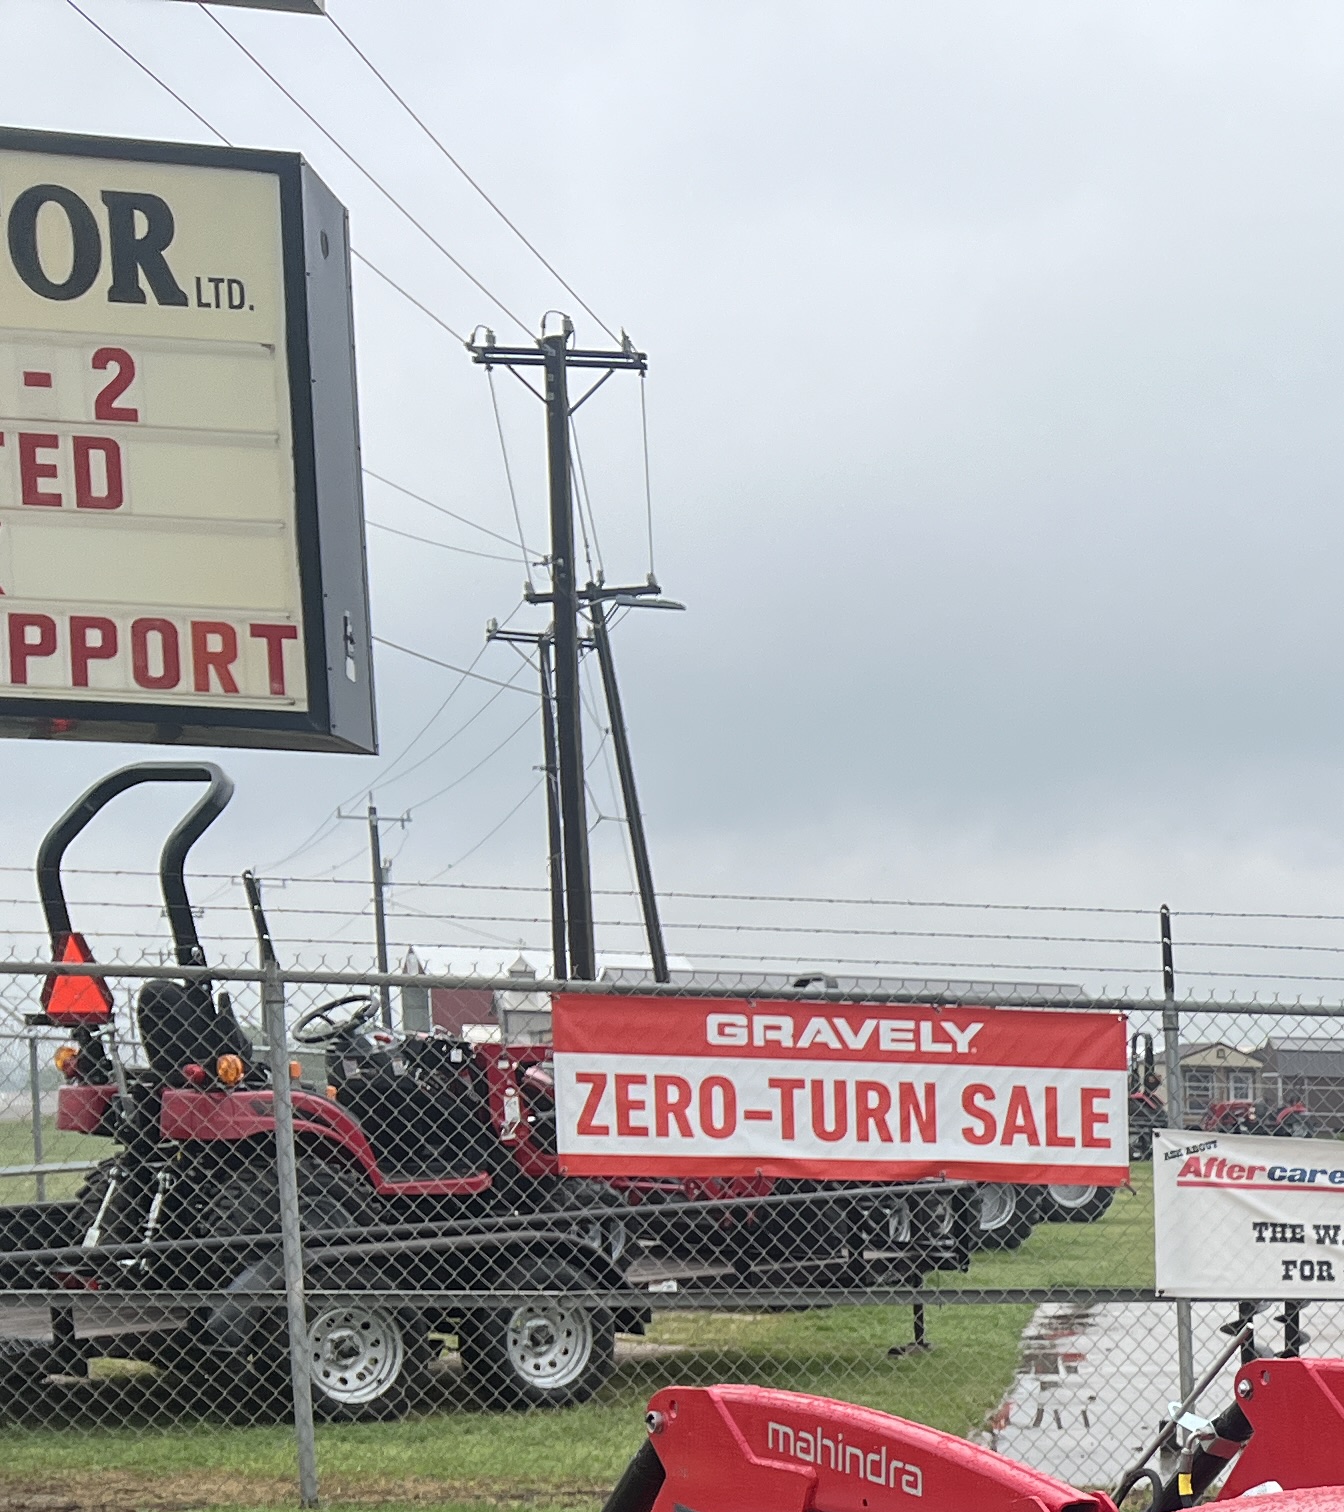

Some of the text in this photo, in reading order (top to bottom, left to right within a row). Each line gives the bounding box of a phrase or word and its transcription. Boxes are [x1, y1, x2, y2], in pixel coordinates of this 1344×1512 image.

[7, 184, 255, 311] OR LTD.
[91, 348, 139, 423] 2
[0, 431, 124, 510] ED
[8, 612, 298, 696] PPORT
[705, 1012, 985, 1055] GRAVELY
[574, 1071, 1112, 1149] ZERO-TURN SALE
[1252, 1222, 1306, 1243] THE
[1281, 1260, 1336, 1282] FOR
[767, 1421, 923, 1497] mahindra
